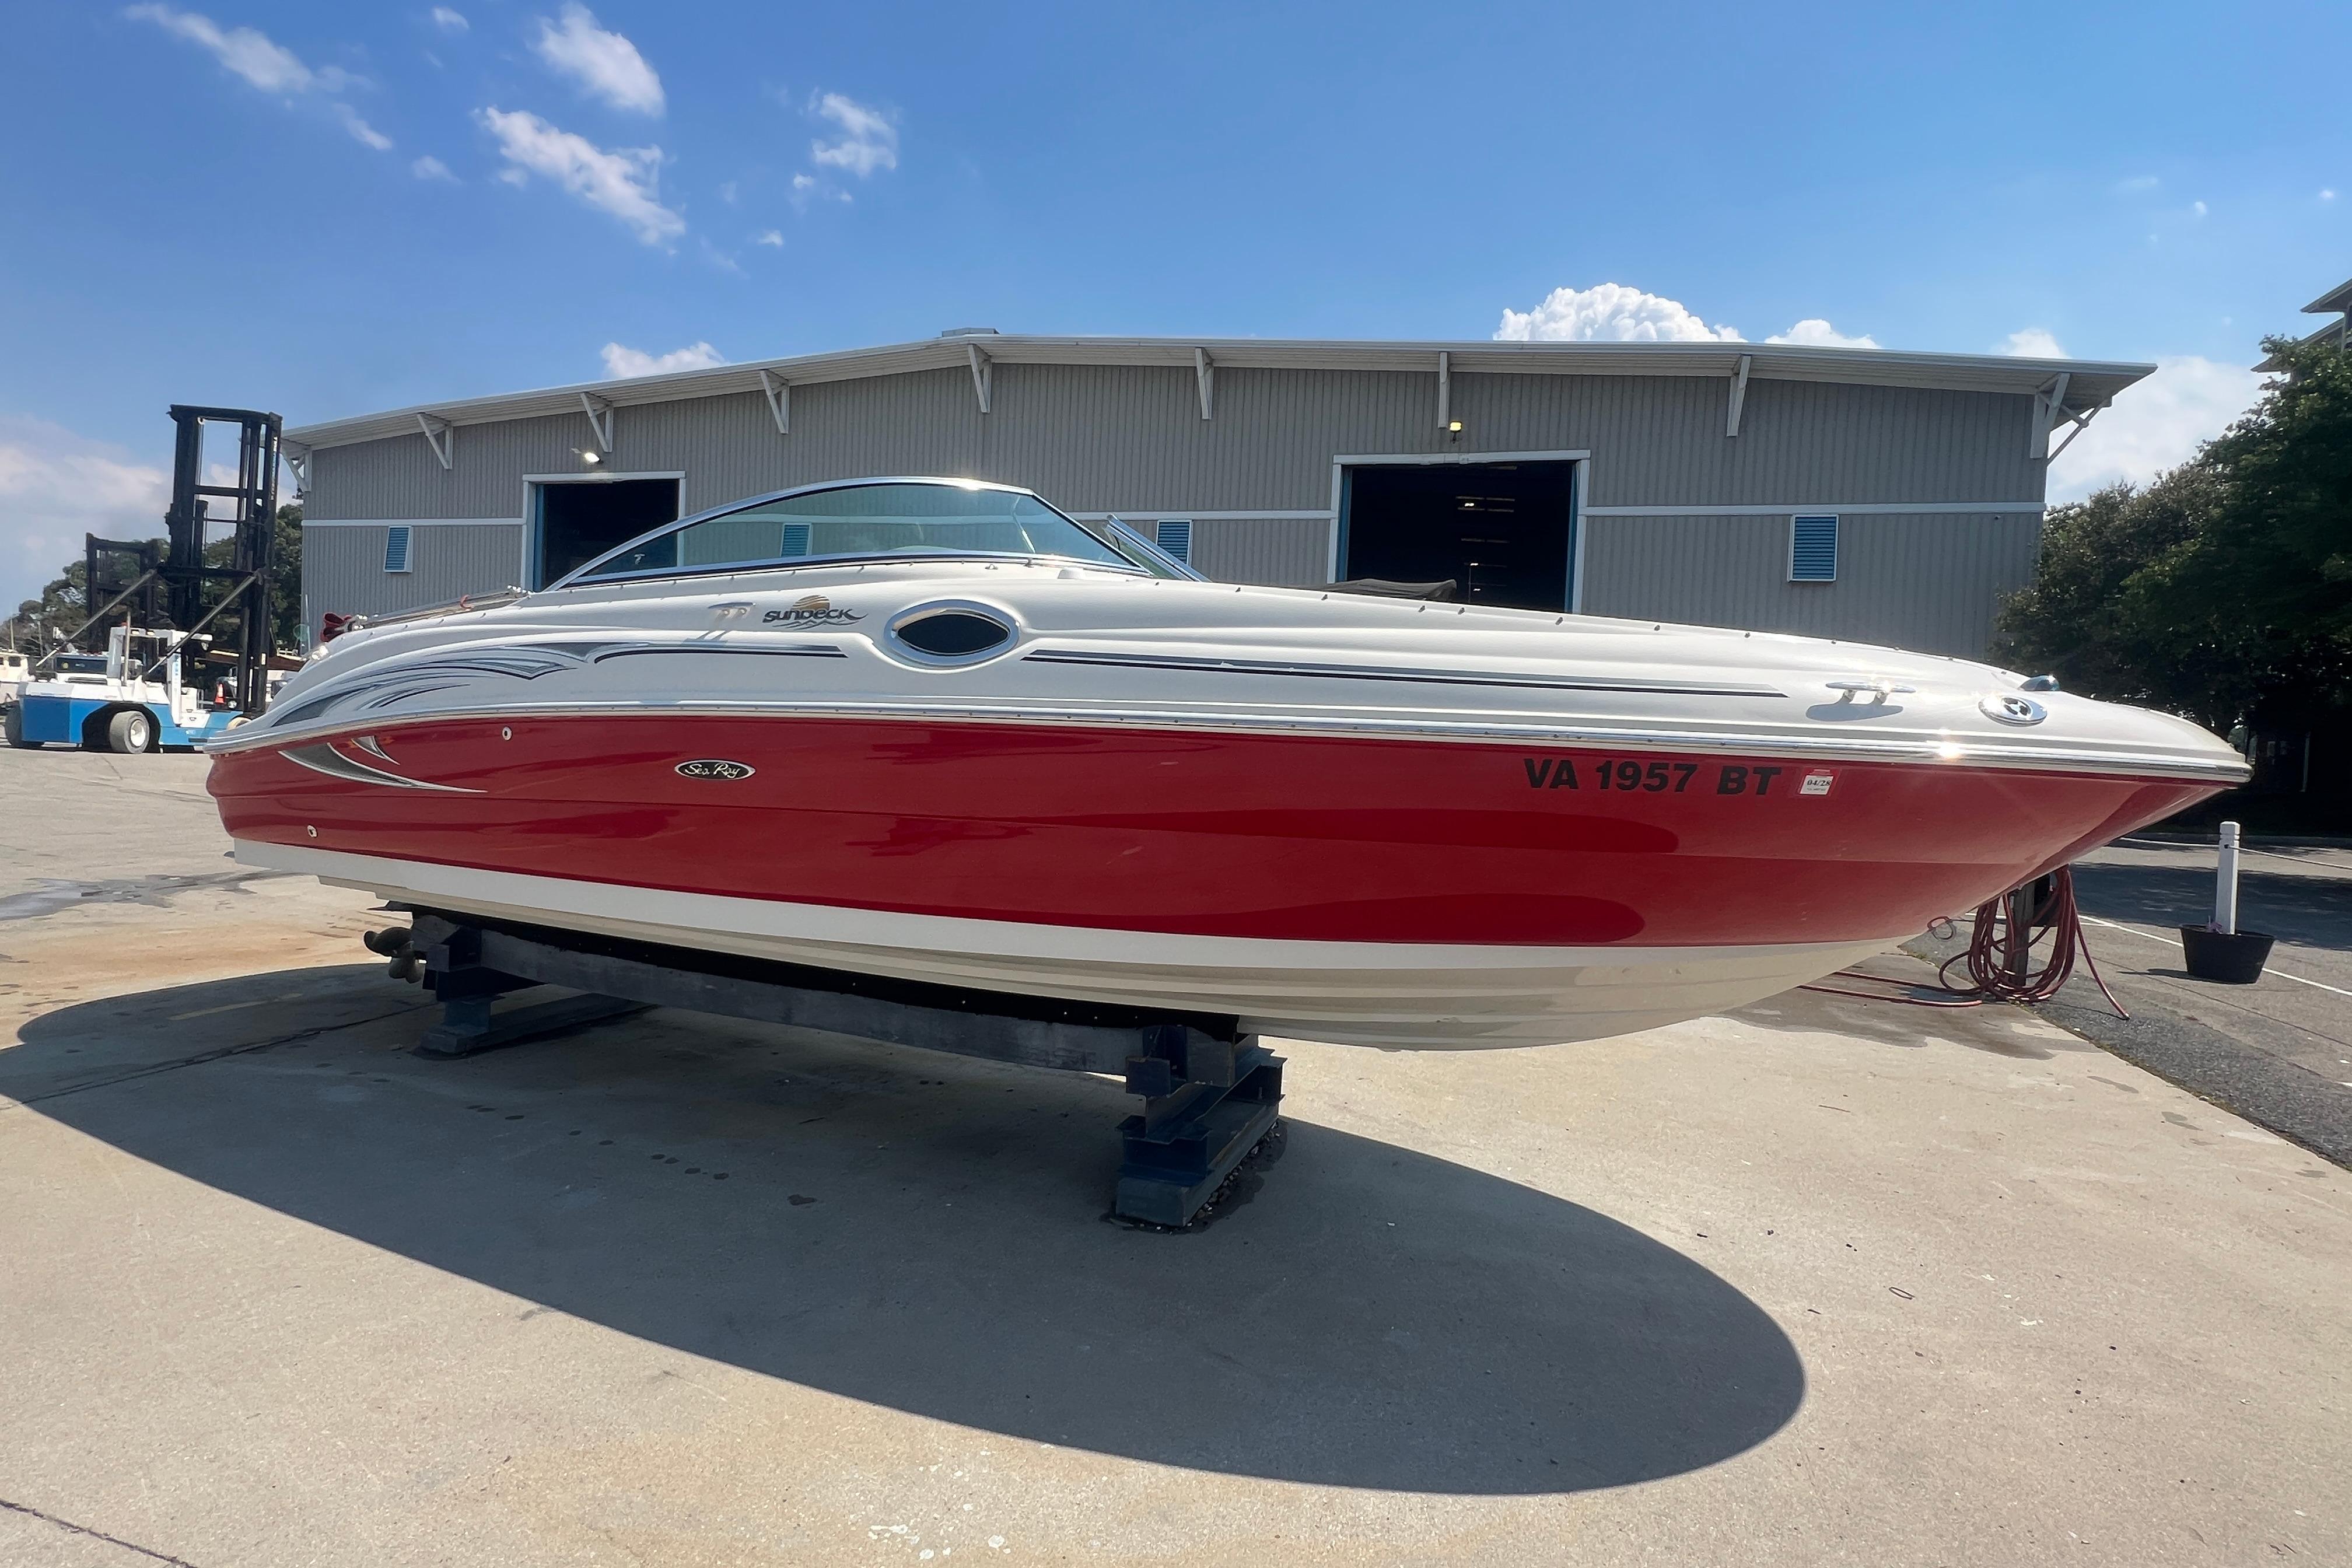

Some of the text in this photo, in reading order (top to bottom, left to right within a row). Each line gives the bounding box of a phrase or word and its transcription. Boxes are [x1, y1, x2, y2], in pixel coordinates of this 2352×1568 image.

[685, 762, 741, 778] Sea Ray
[1524, 758, 1782, 795] VA 1957 BT
